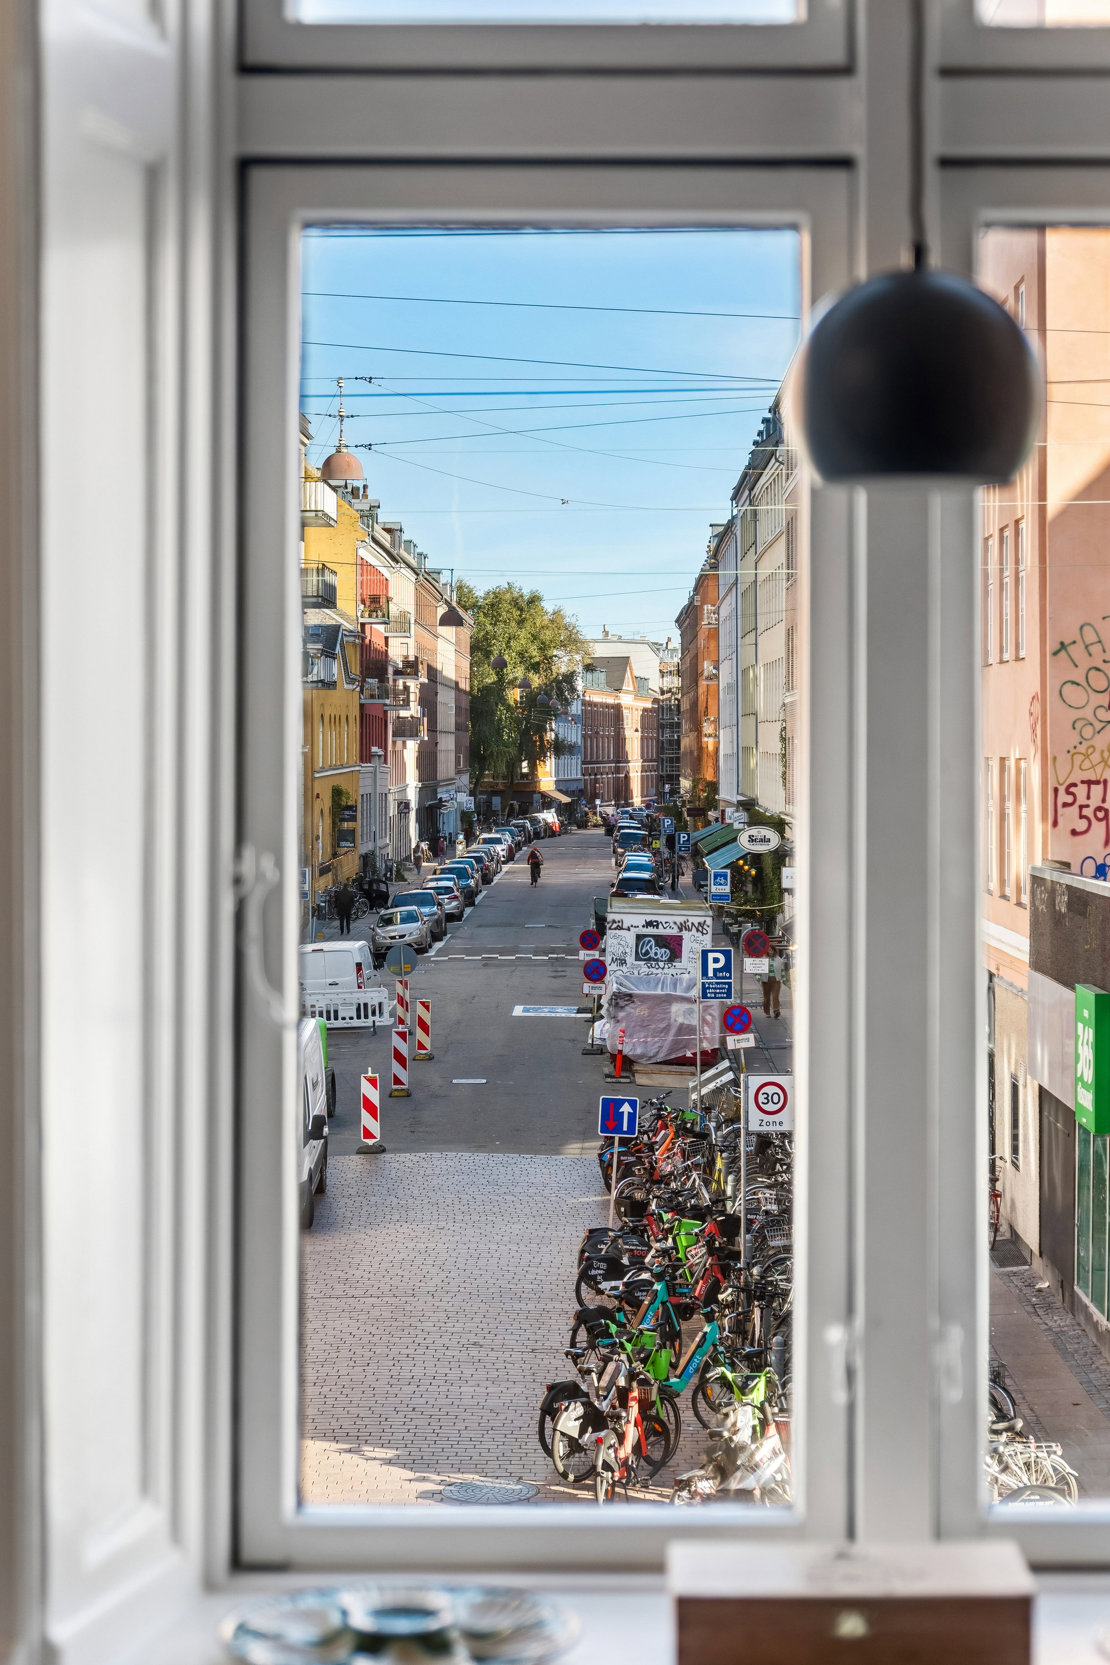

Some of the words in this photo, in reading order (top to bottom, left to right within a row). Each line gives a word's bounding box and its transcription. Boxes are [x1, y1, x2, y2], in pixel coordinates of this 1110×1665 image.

[680, 833, 688, 844] P
[748, 834, 771, 844] Scala
[707, 952, 726, 977] P
[1077, 1022, 1093, 1084] 365
[761, 1092, 781, 1105] 30
[758, 1119, 784, 1127] Zone
[689, 1354, 702, 1374] dott
